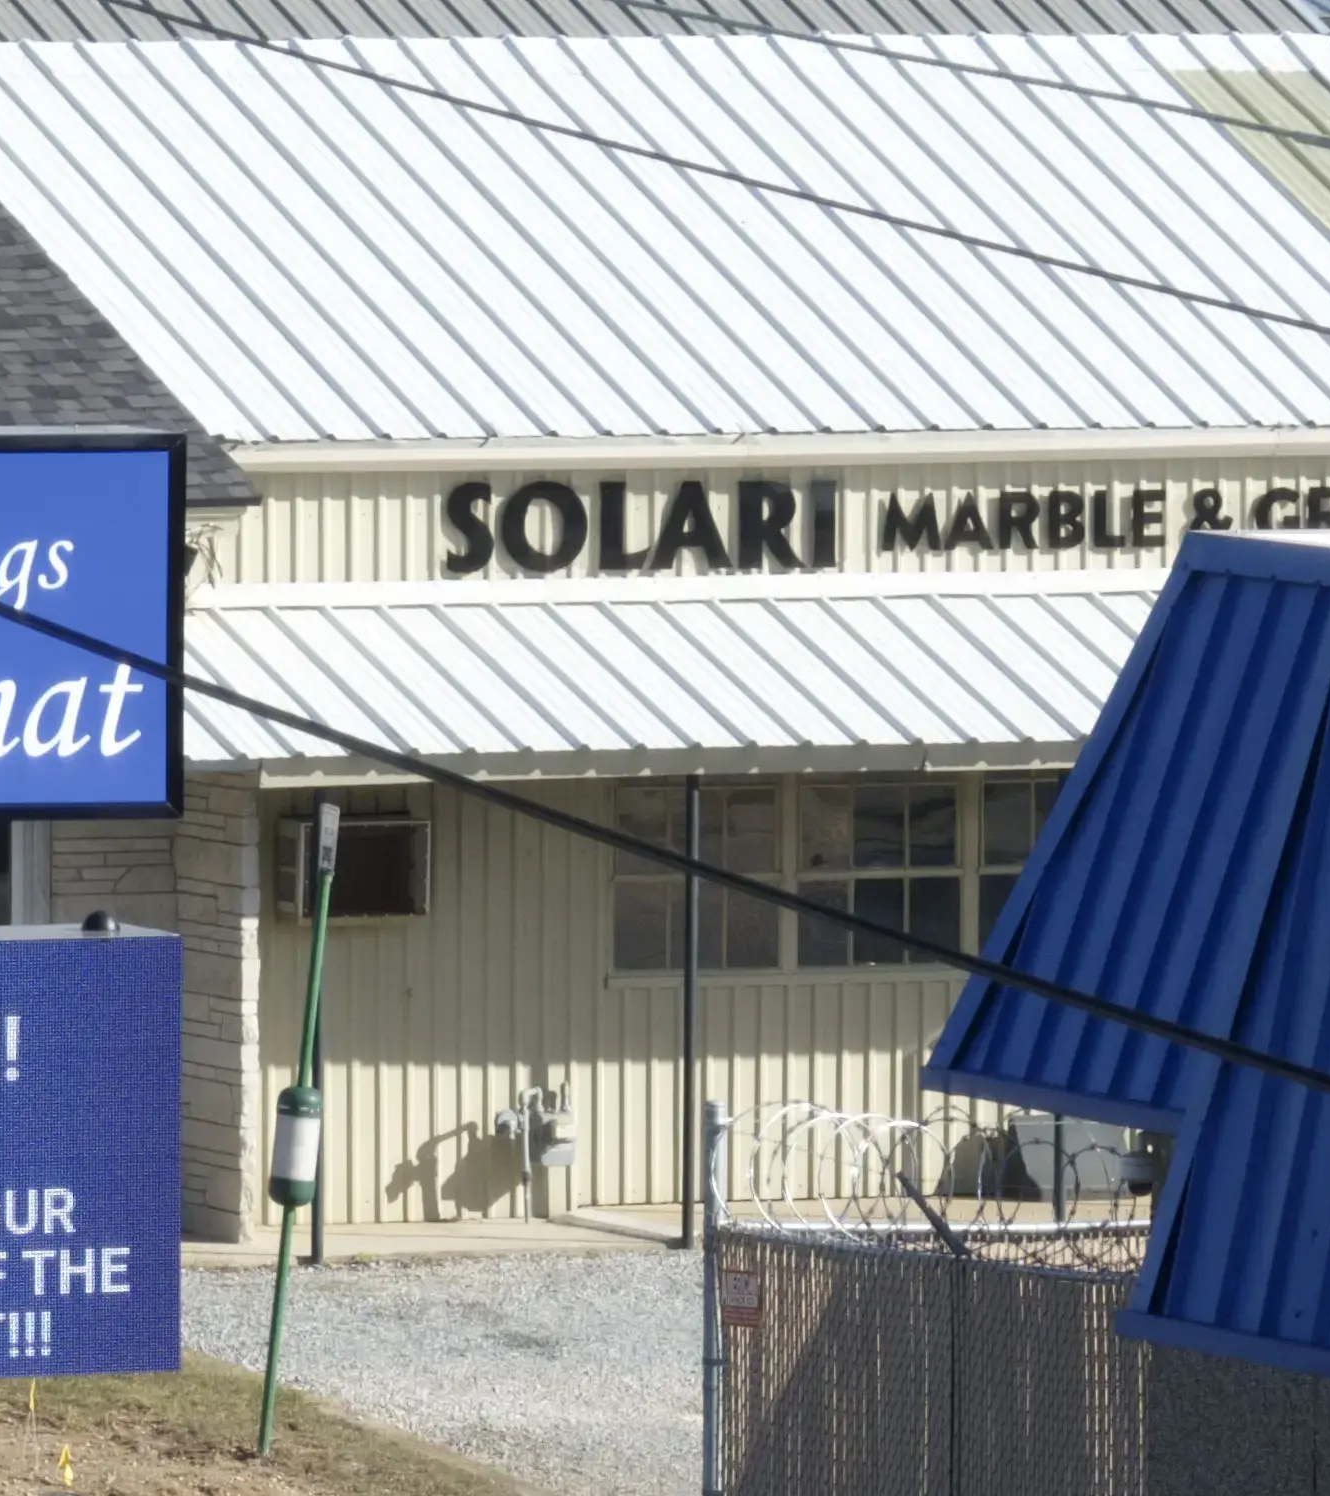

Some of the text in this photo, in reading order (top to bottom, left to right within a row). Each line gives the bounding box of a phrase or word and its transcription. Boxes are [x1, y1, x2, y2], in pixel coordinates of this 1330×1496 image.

[446, 479, 837, 574] SOLARI
[882, 489, 1167, 551] MARBLE
[1189, 488, 1233, 530] &
[22, 1246, 132, 1296] THE
